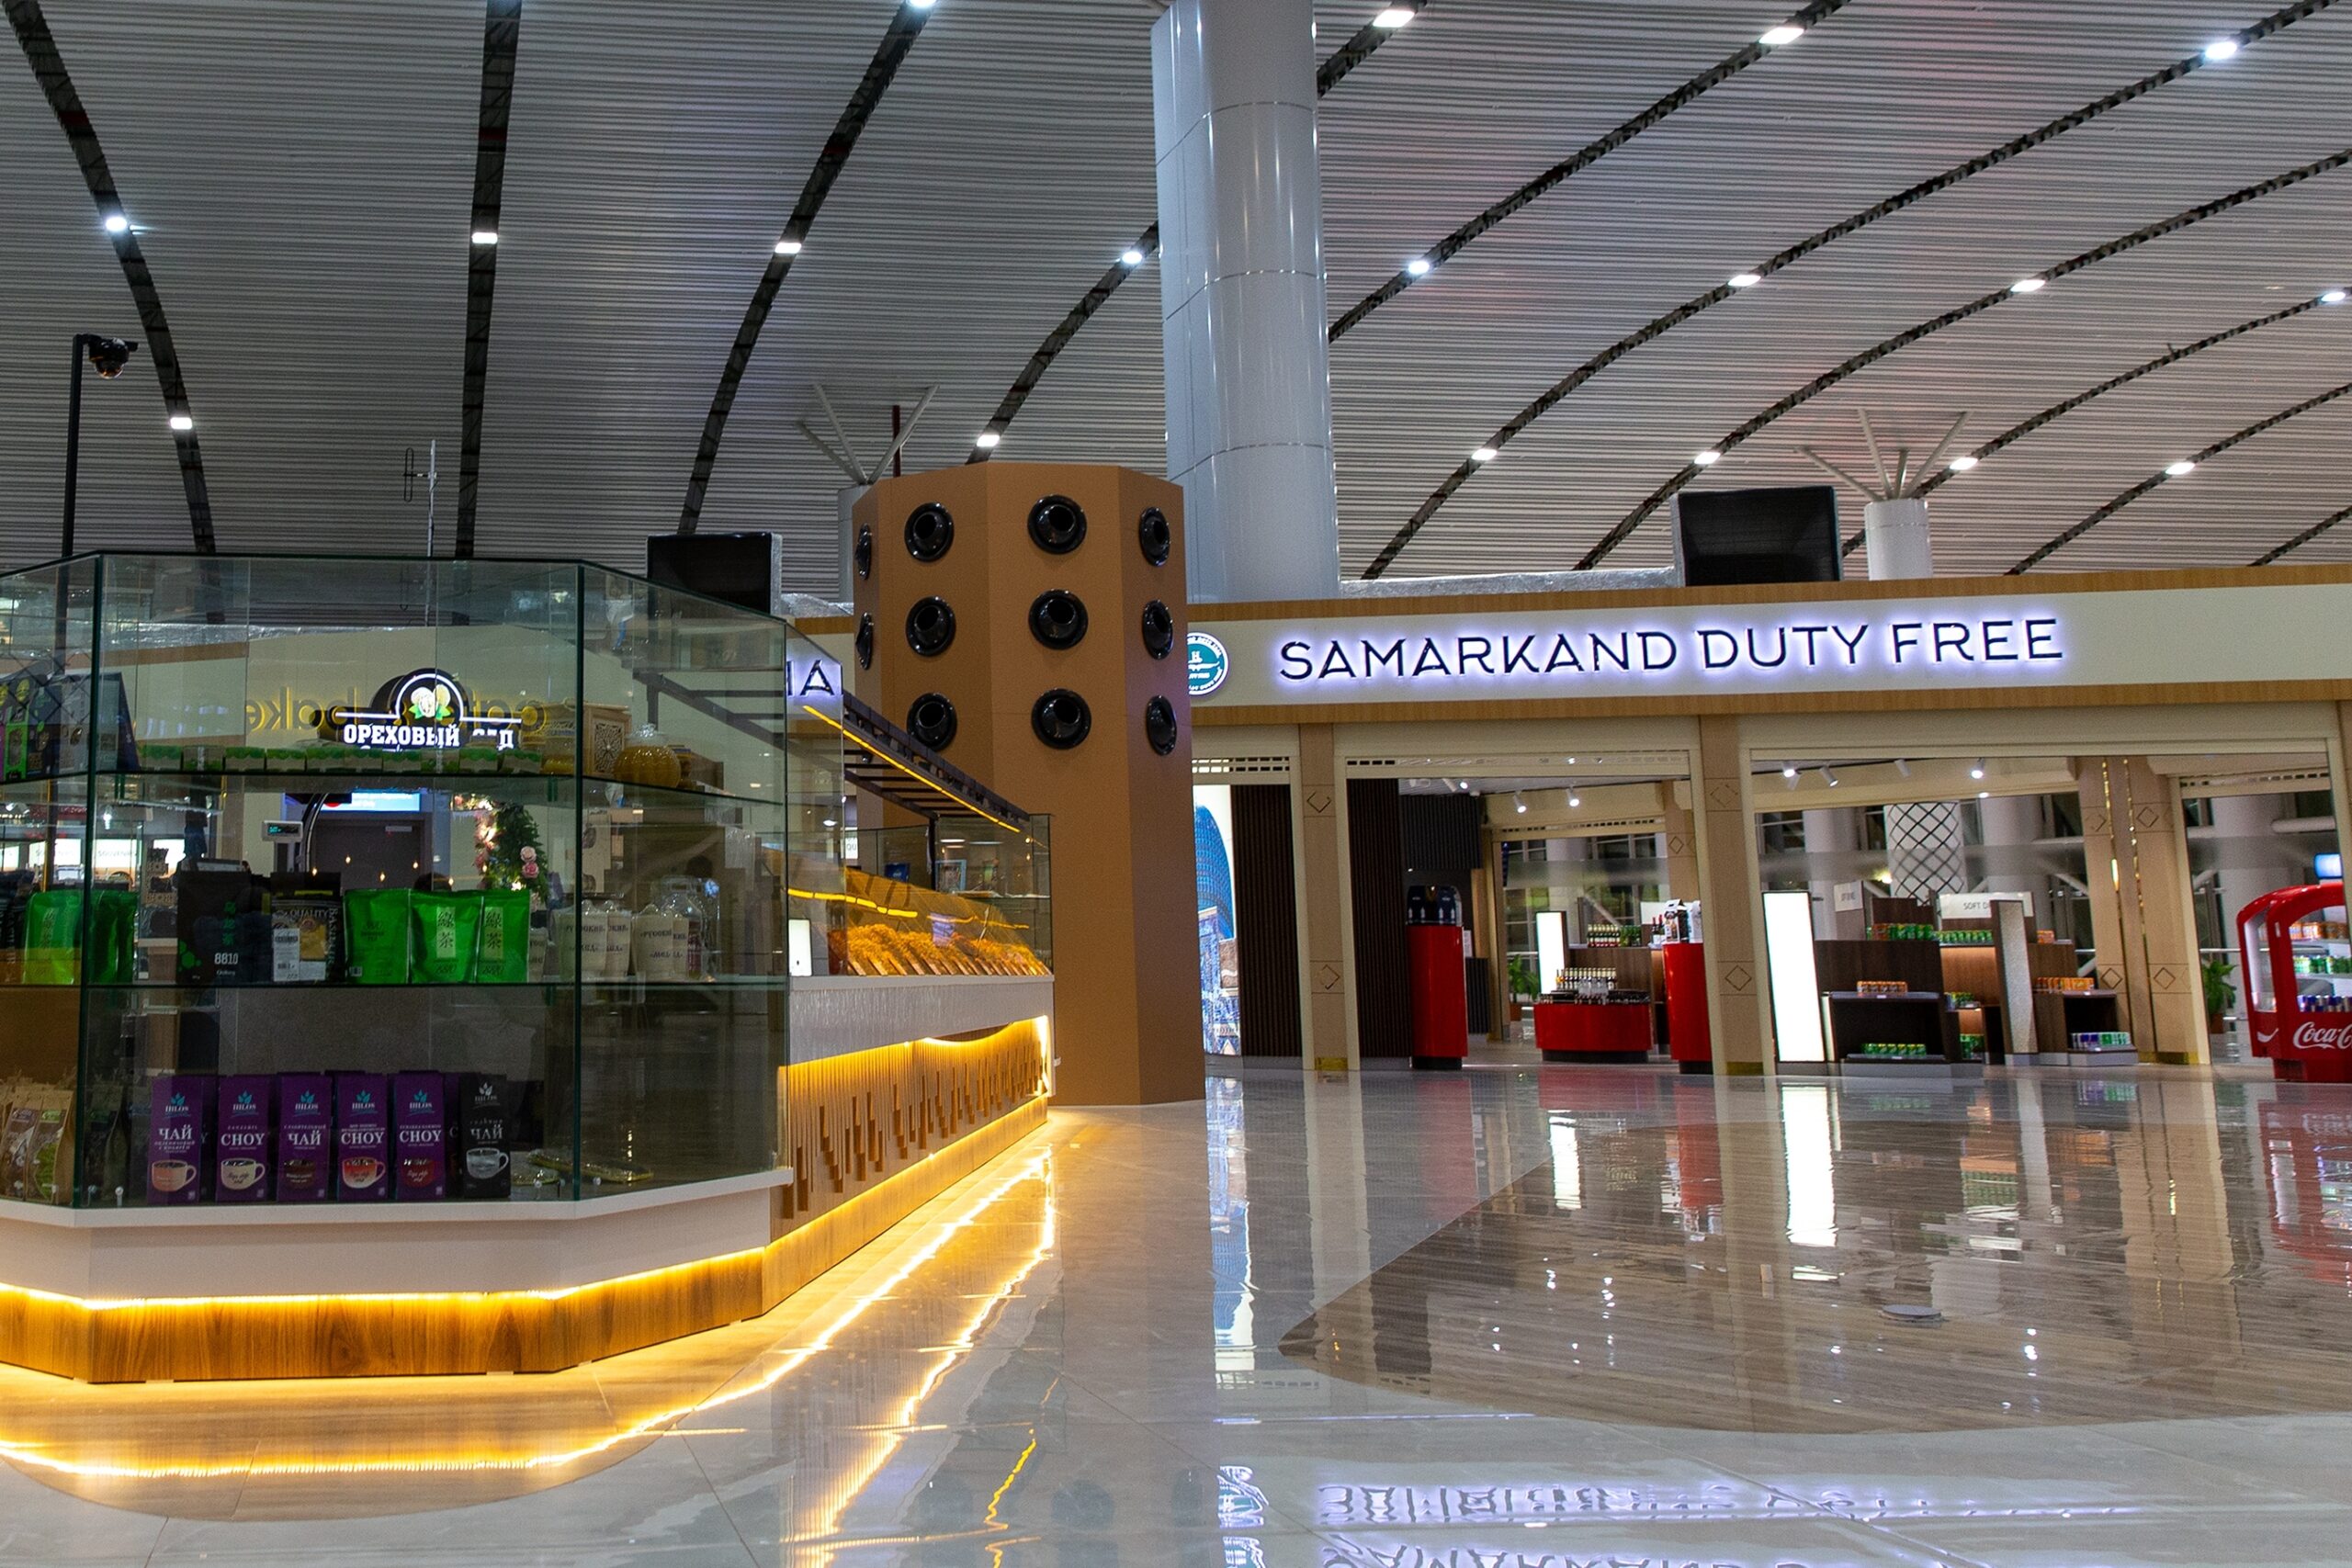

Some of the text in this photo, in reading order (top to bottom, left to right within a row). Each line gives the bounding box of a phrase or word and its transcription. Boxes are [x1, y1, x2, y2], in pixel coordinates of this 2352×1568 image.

[1280, 618, 2064, 681] SAMARKAND DUTY FREE
[343, 723, 460, 747] ОРЕХОВЫЙ
[159, 1124, 193, 1141] ЧАЙ
[220, 1133, 266, 1146] CHOY
[288, 1130, 322, 1146] ЧАЙ
[341, 1132, 384, 1145] CHOY
[399, 1130, 442, 1144] CHOY
[469, 1124, 504, 1140] ЧАЙ
